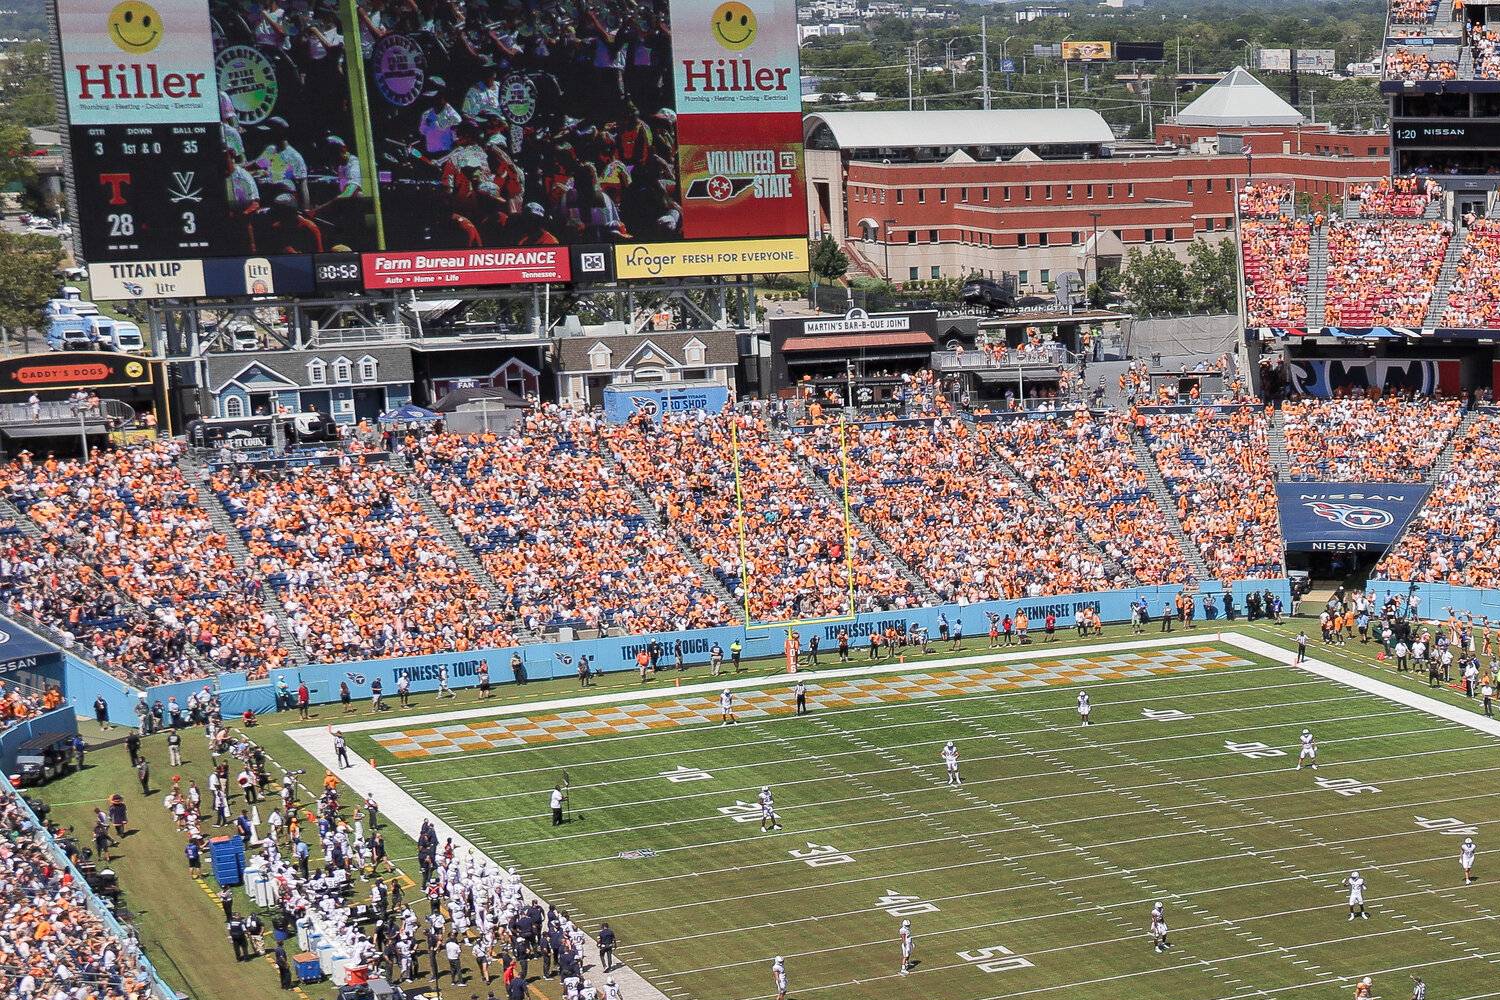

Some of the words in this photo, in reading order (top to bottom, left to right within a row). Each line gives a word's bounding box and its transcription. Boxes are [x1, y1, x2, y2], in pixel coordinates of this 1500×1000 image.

[76, 64, 205, 99] Hiller
[683, 59, 791, 91] Hiller
[1396, 129, 1417, 140] 1:20
[1424, 128, 1465, 136] NISSAN
[95, 142, 104, 155] 3
[153, 142, 161, 154] 0
[183, 141, 198, 153] 35
[706, 150, 776, 175] VOLUNTEER
[100, 173, 131, 205] T
[753, 174, 793, 198] STATE
[108, 214, 134, 236] 28
[182, 212, 196, 234] 3
[375, 257, 411, 271] Farm
[415, 255, 465, 270] Bureau
[468, 252, 556, 267] INSURANCE
[586, 255, 602, 269] 25
[626, 246, 676, 274] Kroger
[682, 255, 714, 264] FRESH
[718, 254, 738, 263] FOR
[742, 251, 794, 262] EVERYONE
[110, 263, 156, 279] TITAN
[161, 262, 181, 277] UP
[248, 264, 269, 279] Lite
[385, 276, 403, 284] Auto
[414, 275, 435, 283] Home
[445, 274, 459, 282] Life
[156, 282, 176, 295] Lite
[807, 321, 843, 332] MARTIN'S
[845, 320, 885, 331] BAR-B-QUE
[886, 318, 907, 328] JOINT
[22, 369, 69, 379] DADDY'S
[74, 368, 104, 377] DOGS
[662, 400, 680, 411] PRO
[683, 399, 707, 410] SHOP
[1300, 493, 1405, 501] NISSAN
[1312, 542, 1367, 550] NISSAN
[788, 640, 797, 673] VOLS
[1314, 777, 1382, 797] 30
[1414, 816, 1479, 835] 40
[788, 844, 856, 867] 30
[875, 893, 940, 917] 40
[956, 944, 1036, 973] 50
